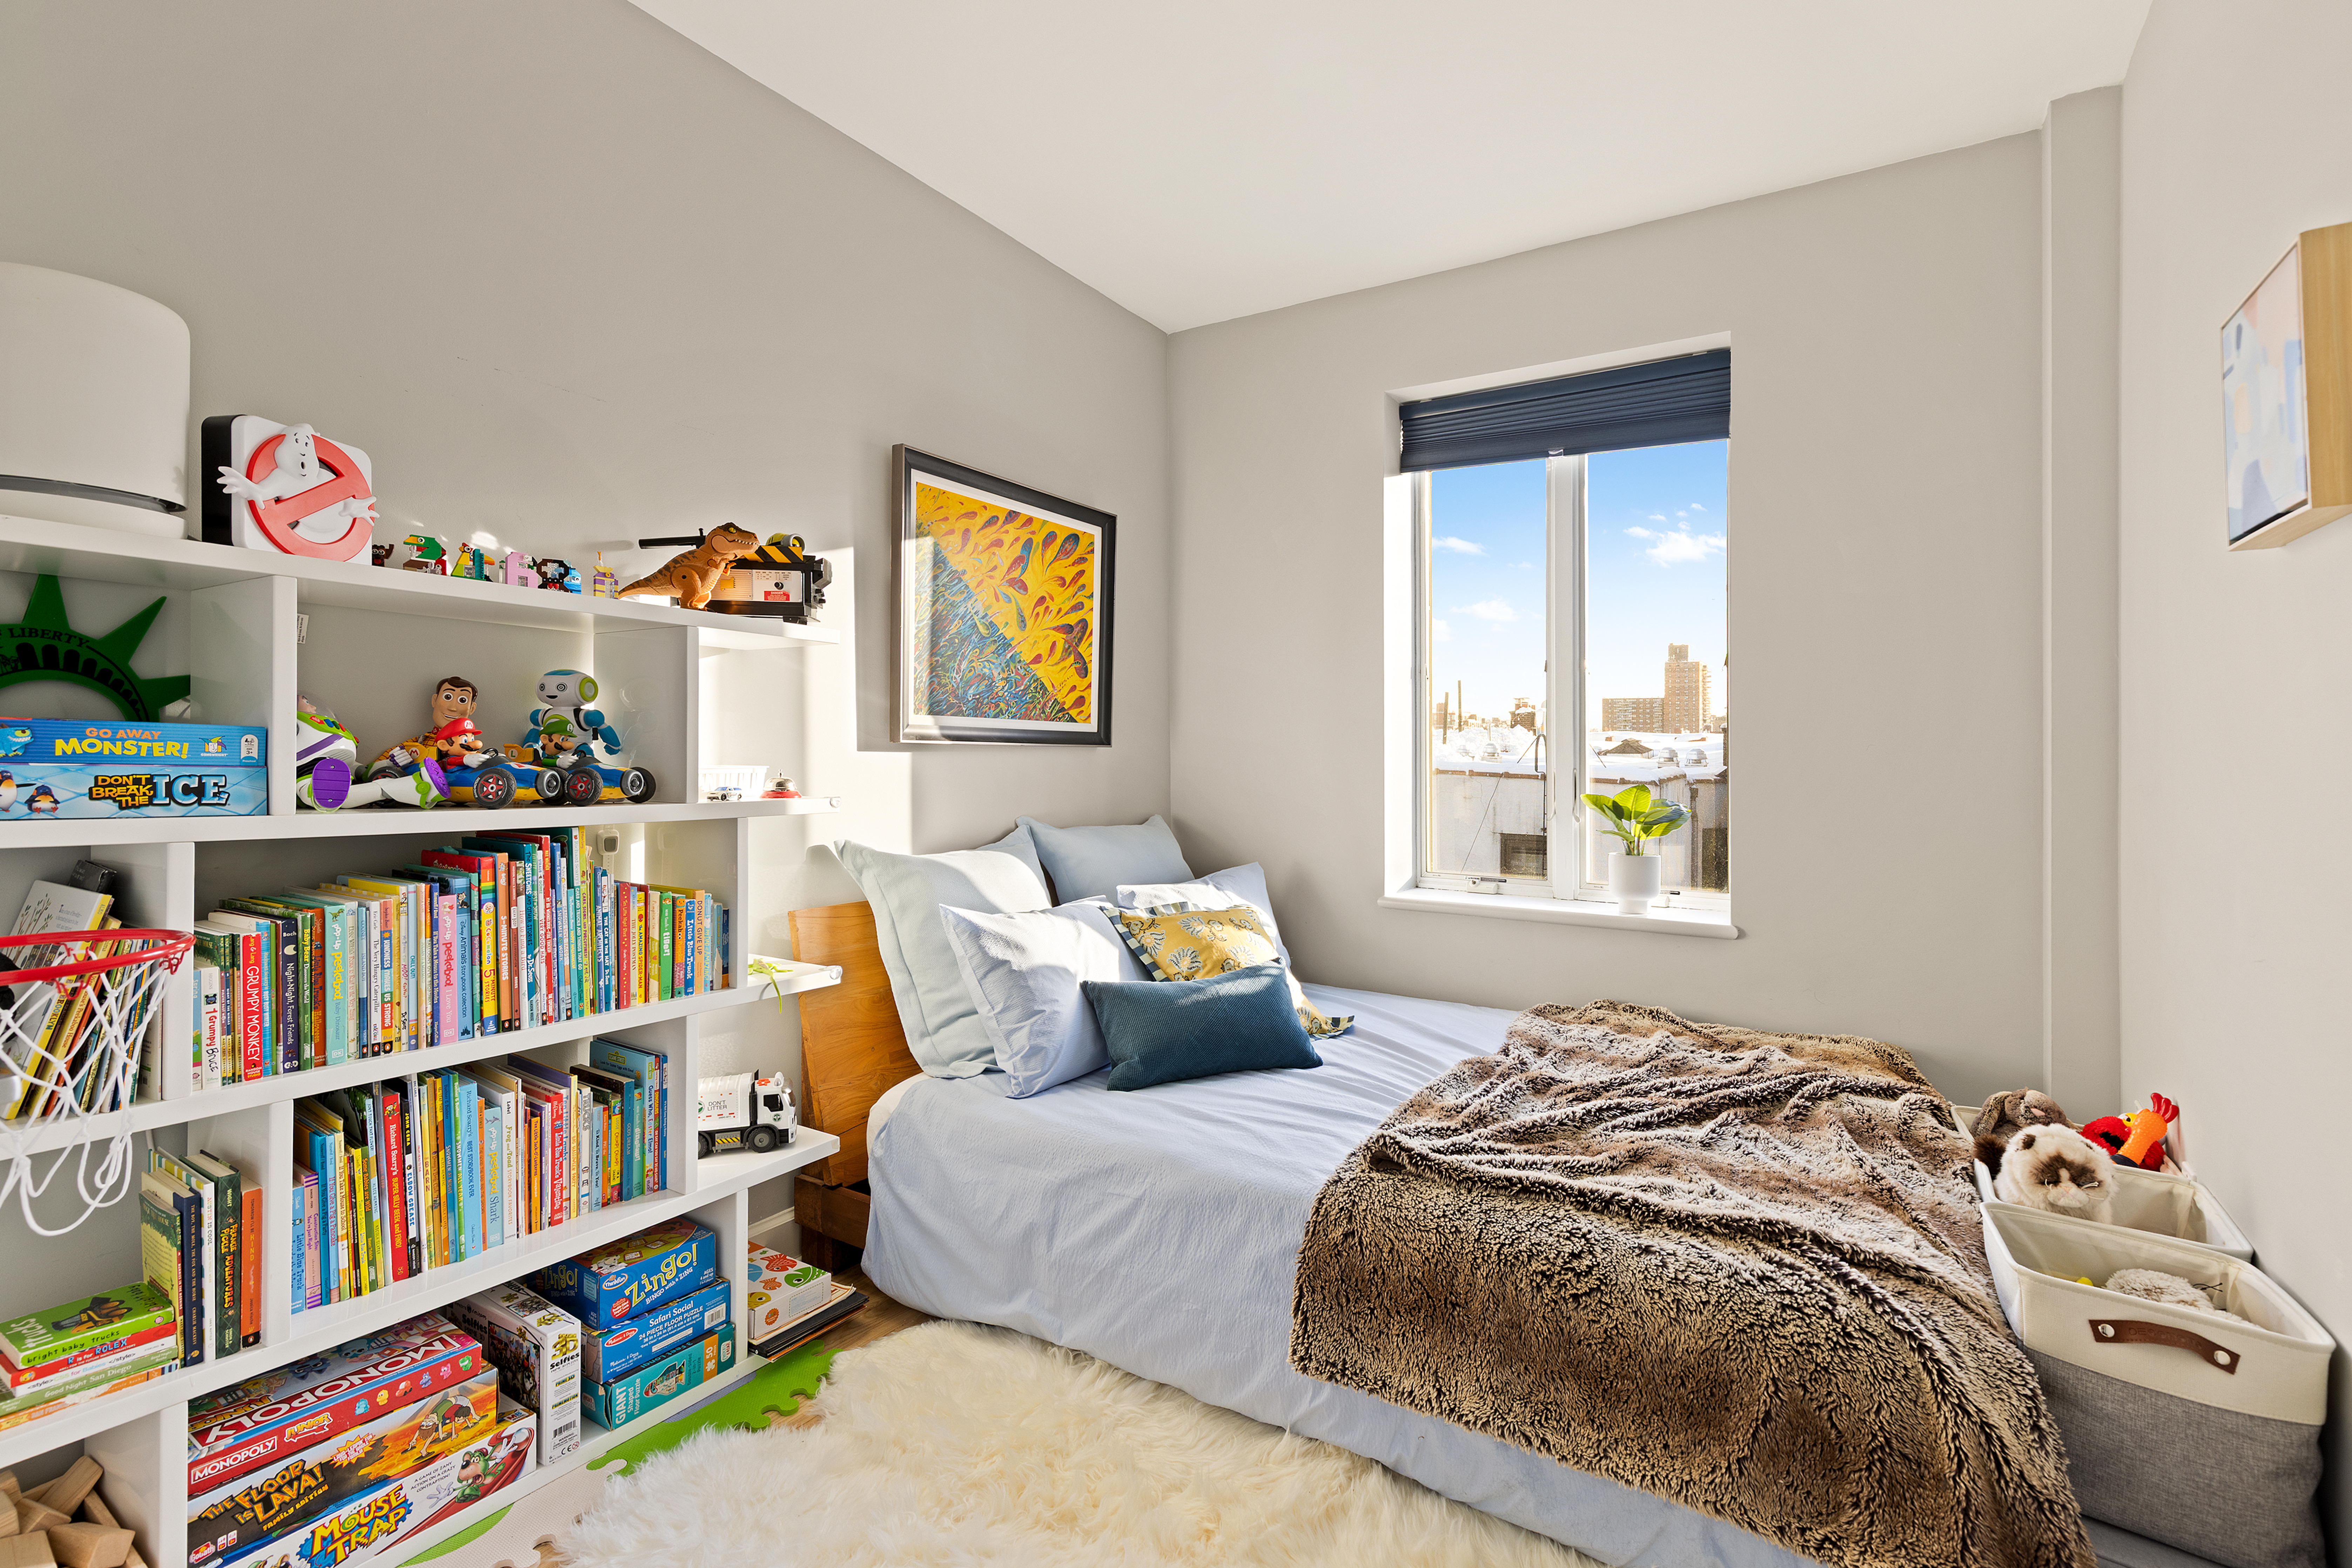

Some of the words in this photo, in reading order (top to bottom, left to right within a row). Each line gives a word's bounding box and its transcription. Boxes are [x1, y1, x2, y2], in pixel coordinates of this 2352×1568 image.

[8, 627, 90, 648] LIBERTY
[85, 728, 112, 738] GO
[116, 729, 161, 739] AWAY
[55, 738, 189, 759] MONSTER!
[92, 785, 154, 798] BREAK
[153, 775, 229, 804] ICE
[98, 775, 150, 785] DON'T
[116, 796, 149, 807] THE
[302, 928, 310, 945] Baby
[331, 924, 342, 950] pop-up
[443, 915, 452, 940] pop-up
[442, 942, 454, 987] peekaboo!
[697, 947, 702, 955] UP
[247, 966, 260, 1012] GRUMPY
[285, 963, 295, 1004] Night-Night,
[331, 952, 344, 1000] peekaboo!
[384, 993, 391, 1002] US
[62, 1032, 74, 1048] House
[206, 1015, 217, 1047] Grumpy
[247, 1014, 260, 1061] MONKEY
[582, 1093, 591, 1131] TRUCKS
[489, 1127, 497, 1150] pop-up
[390, 1150, 399, 1175] Scarry's
[488, 1151, 499, 1195] peekaboo!
[553, 1177, 563, 1210] Valentine
[490, 1196, 500, 1224] Shark
[296, 1251, 304, 1269] Blue
[703, 1267, 714, 1275] AGES
[542, 1264, 579, 1293] Zingo!
[624, 1242, 698, 1308] Zingo!
[645, 1288, 665, 1305] BINGO
[665, 1280, 677, 1291] with
[679, 1266, 694, 1279] ZING
[461, 1313, 488, 1334] Selfies
[638, 1332, 646, 1340] 24
[646, 1325, 664, 1337] PIECE
[664, 1316, 683, 1330] FLOOR
[683, 1305, 704, 1320] PUZZLE
[649, 1310, 672, 1328] Safari
[672, 1300, 694, 1315] Social
[27, 1349, 59, 1364] bright
[62, 1343, 85, 1352] baby
[91, 1330, 120, 1343] trucks
[67, 1356, 75, 1365] R
[94, 1338, 128, 1356] ROLEX
[551, 1337, 579, 1361] 3D
[706, 1346, 713, 1359] 50
[82, 1362, 107, 1373] Babies
[550, 1352, 580, 1370] Selfies
[640, 1354, 666, 1368] Long!
[44, 1386, 65, 1398] Good
[65, 1380, 87, 1392] Night
[89, 1374, 106, 1383] San
[107, 1364, 132, 1377] Diego
[203, 1338, 450, 1445] MONOPOLY
[615, 1386, 627, 1425] GIANT
[194, 1439, 275, 1481] MONOPOLY
[286, 1413, 332, 1440] JUNIOR
[410, 1481, 427, 1491] ACTION
[441, 1465, 456, 1477] CRAZY
[416, 1473, 451, 1493] CONTRAPTION!
[418, 1472, 432, 1481] GAME
[439, 1461, 453, 1471] ZANY
[201, 1496, 235, 1520] THE
[234, 1460, 304, 1508] FLOOR
[254, 1465, 324, 1522] LAVA!
[262, 1508, 294, 1532] FAMILY
[295, 1483, 329, 1510] EDITION
[312, 1483, 407, 1557] MOUSE
[326, 1506, 407, 1564] TRAP
[190, 1546, 214, 1560] Goliath
